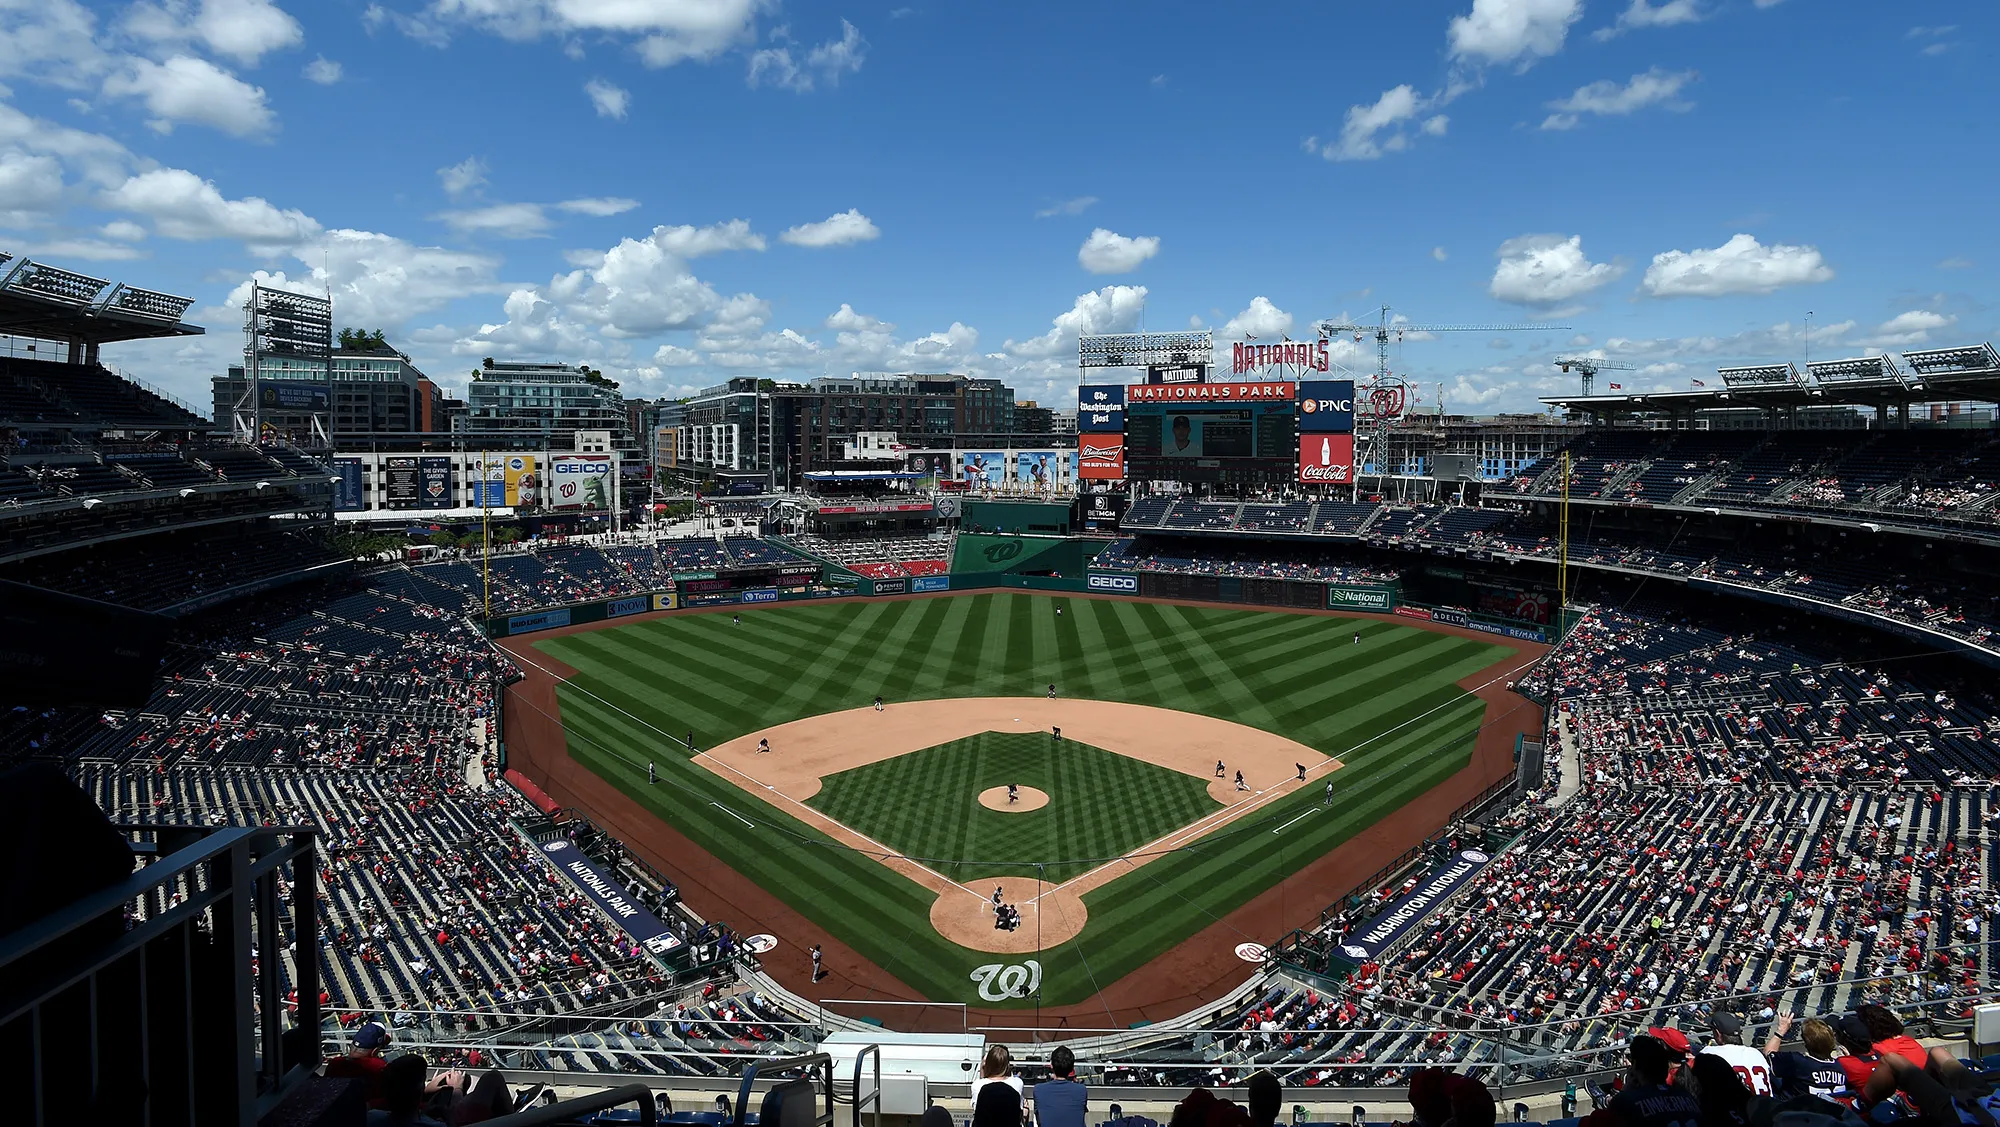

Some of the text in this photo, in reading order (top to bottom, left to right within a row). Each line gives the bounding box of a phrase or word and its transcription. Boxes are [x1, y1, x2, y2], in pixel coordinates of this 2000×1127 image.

[1233, 340, 1328, 373] NATIONALS
[1162, 369, 1199, 381] NATITUDE
[1094, 391, 1108, 401] The
[1134, 386, 1285, 398] NATIONALS PARK
[1080, 401, 1122, 412] Washington
[1319, 400, 1350, 411] PNC
[1092, 414, 1109, 424] Post
[1084, 448, 1117, 456] Budweiser
[555, 464, 608, 473] GEICO
[1302, 464, 1349, 480] Coca-Cola
[1090, 577, 1134, 588] GEICO
[1345, 592, 1384, 603] National
[618, 601, 645, 613] INOVA
[511, 620, 526, 628] BUD
[1440, 614, 1465, 623] DELTA
[1469, 622, 1501, 634] amentum
[1510, 629, 1538, 641] RE/MAX
[567, 861, 639, 919] NATIONALS PARK
[1362, 861, 1473, 944] WASHINGTON NATIONALS
[643, 938, 665, 954] MLB
[1812, 1070, 1846, 1085] SUZUKI
